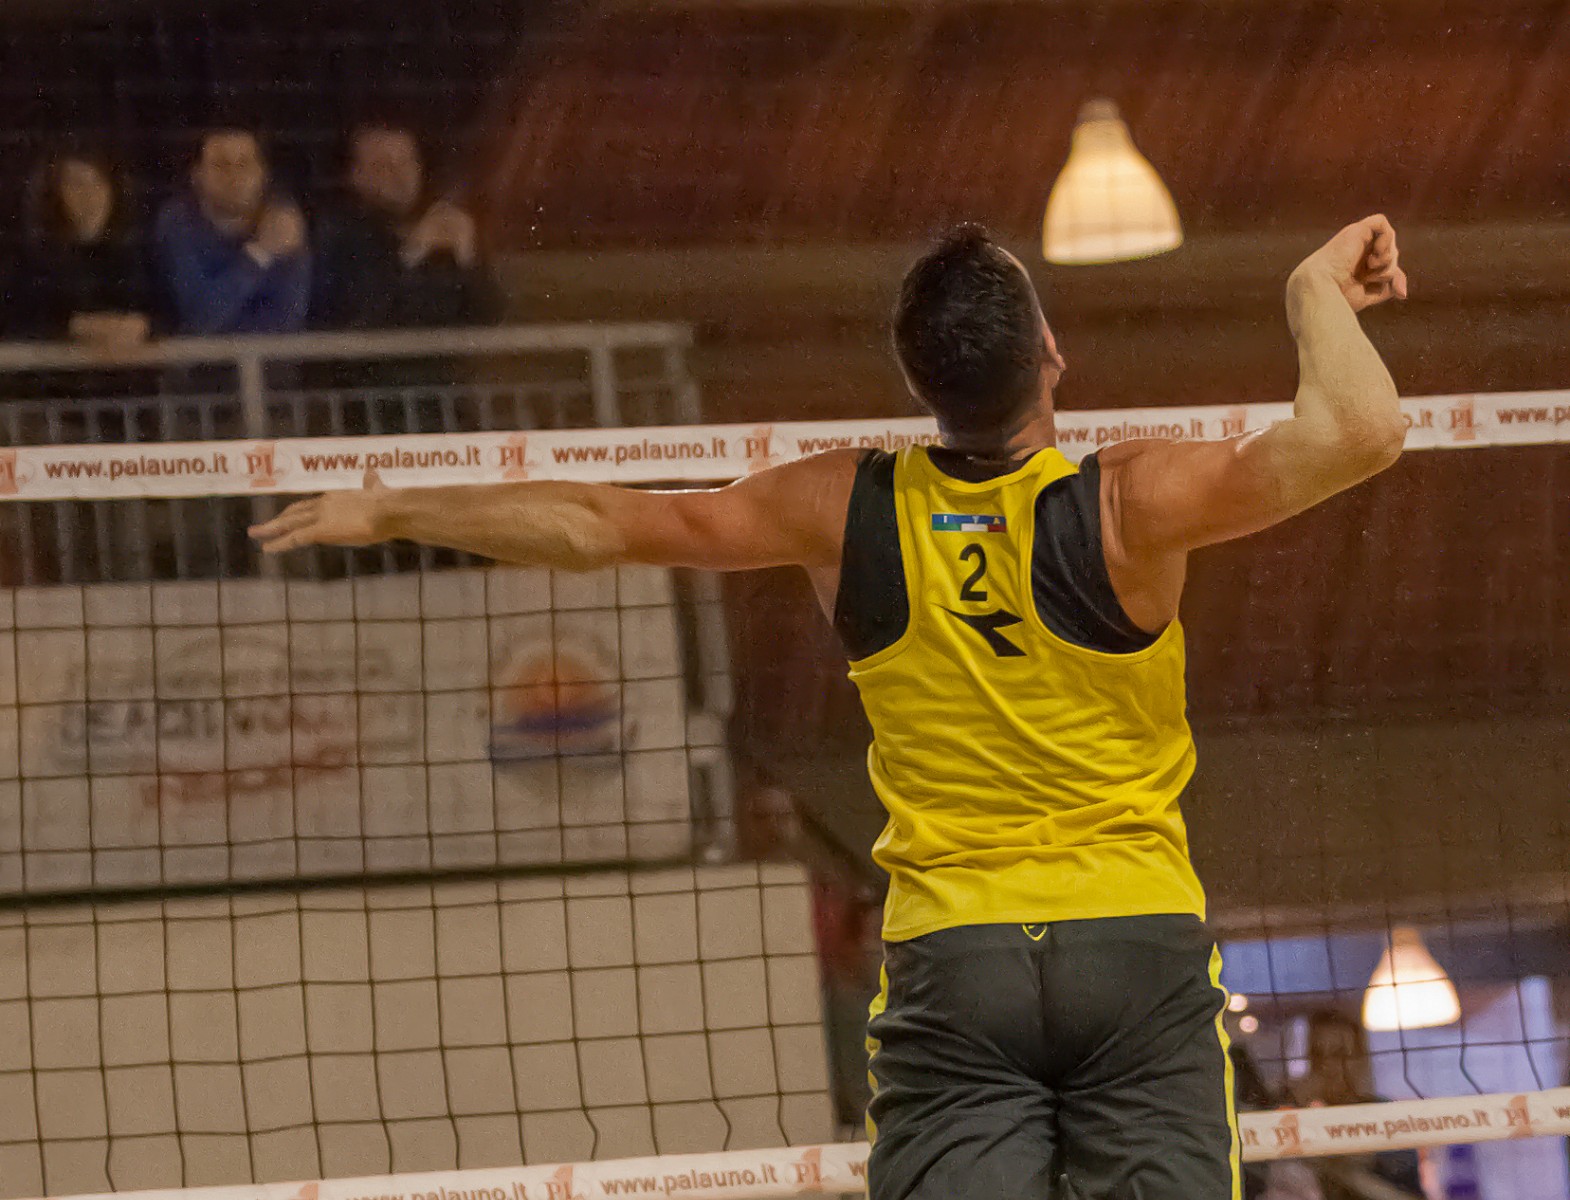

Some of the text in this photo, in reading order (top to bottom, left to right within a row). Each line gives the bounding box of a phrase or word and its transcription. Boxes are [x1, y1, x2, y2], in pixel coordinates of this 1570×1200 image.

[44, 453, 228, 481] www.palauno.it
[300, 445, 481, 471] www.palauno.it
[551, 437, 727, 466] www.palauno.it
[958, 542, 988, 602] 2
[600, 1164, 778, 1196] www.palauno.it
[1324, 1108, 1491, 1139] www.palauno.it
